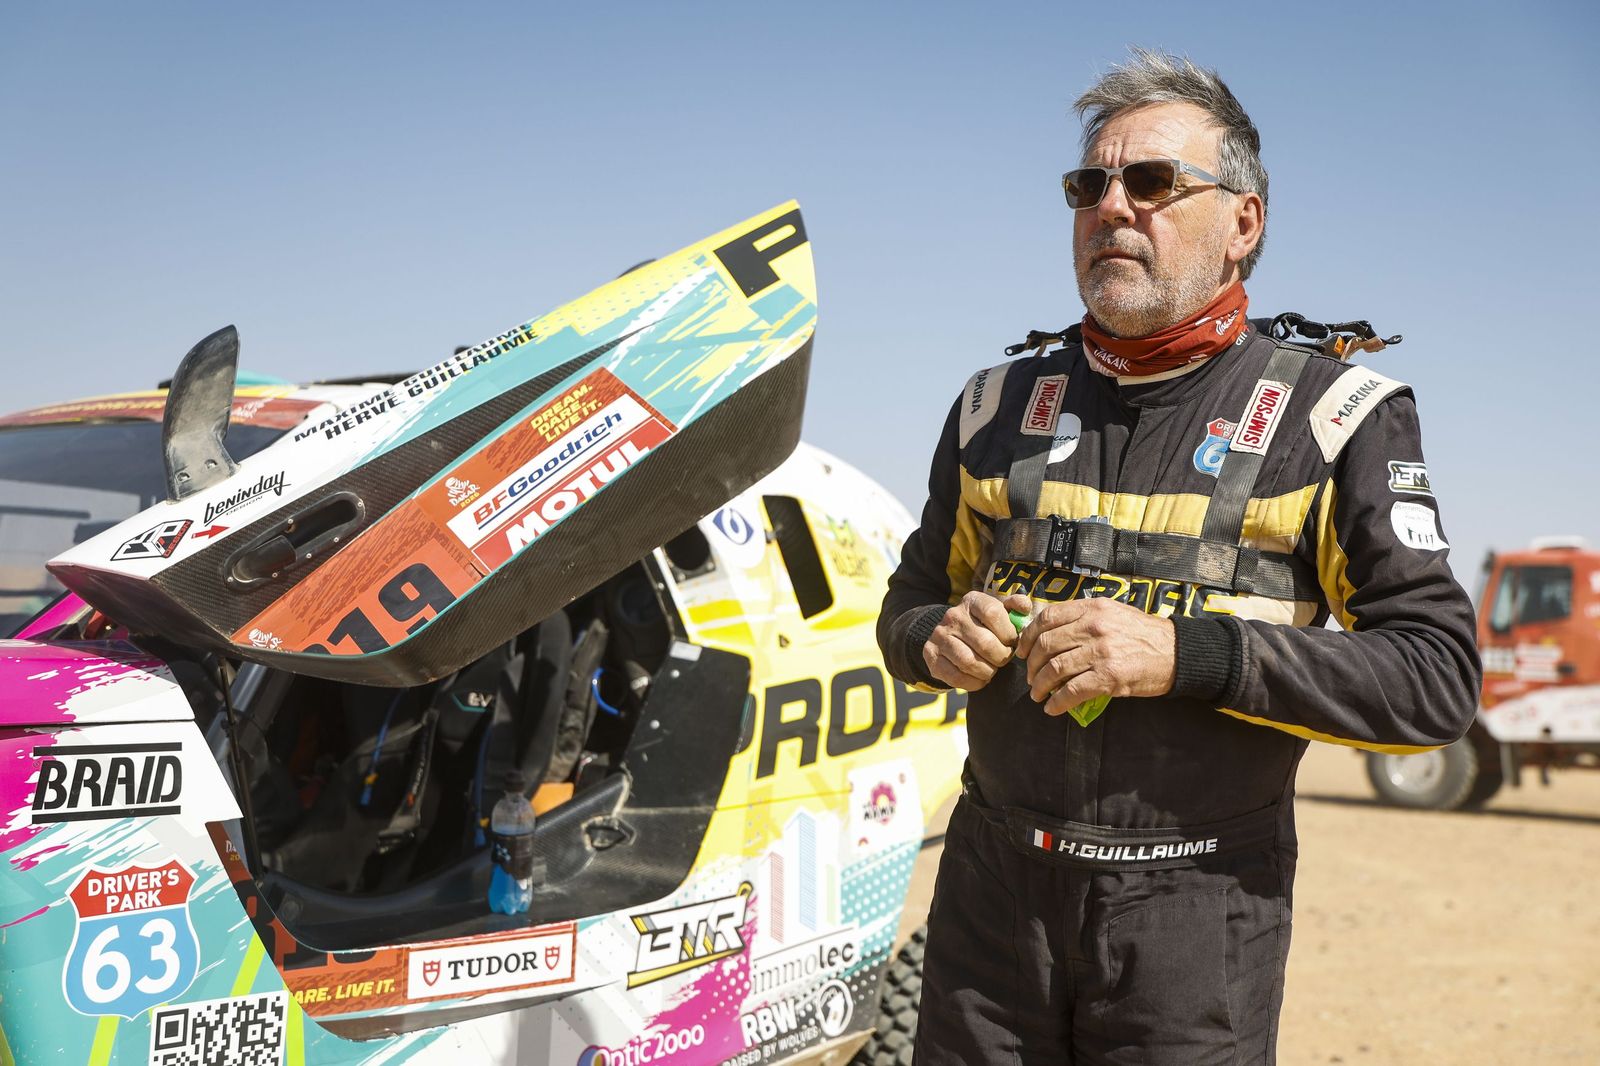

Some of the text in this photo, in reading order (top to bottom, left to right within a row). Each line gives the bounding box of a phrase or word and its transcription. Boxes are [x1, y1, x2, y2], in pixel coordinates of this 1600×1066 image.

[713, 209, 809, 298] P
[294, 389, 396, 442] MAXIME
[403, 323, 532, 387] GUILLAUME
[325, 395, 401, 440] HERVE
[407, 329, 539, 398] GUILLAUME
[530, 383, 594, 430] DREAM.
[1031, 380, 1059, 428] SIMPSON
[1330, 379, 1382, 426] MARINA
[537, 399, 587, 435] DARE.
[545, 411, 582, 443] LIVE
[582, 399, 603, 418] IT.
[1243, 387, 1281, 445] SIMPSON
[473, 411, 622, 525] BFGoodrich
[505, 440, 650, 556] MOTUL
[303, 562, 458, 655] 19
[32, 755, 182, 810] BRAID
[1058, 838, 1218, 860] H.GUILLAUME
[88, 868, 180, 897] DRIVER'S
[106, 889, 162, 914] PARK
[82, 918, 181, 1004] 63
[448, 951, 539, 981] TUDOR
[753, 942, 854, 996] immolec
[294, 979, 396, 1005] ARE. LIVE IT.
[740, 999, 798, 1048] RBW
[763, 1043, 778, 1058] BY
